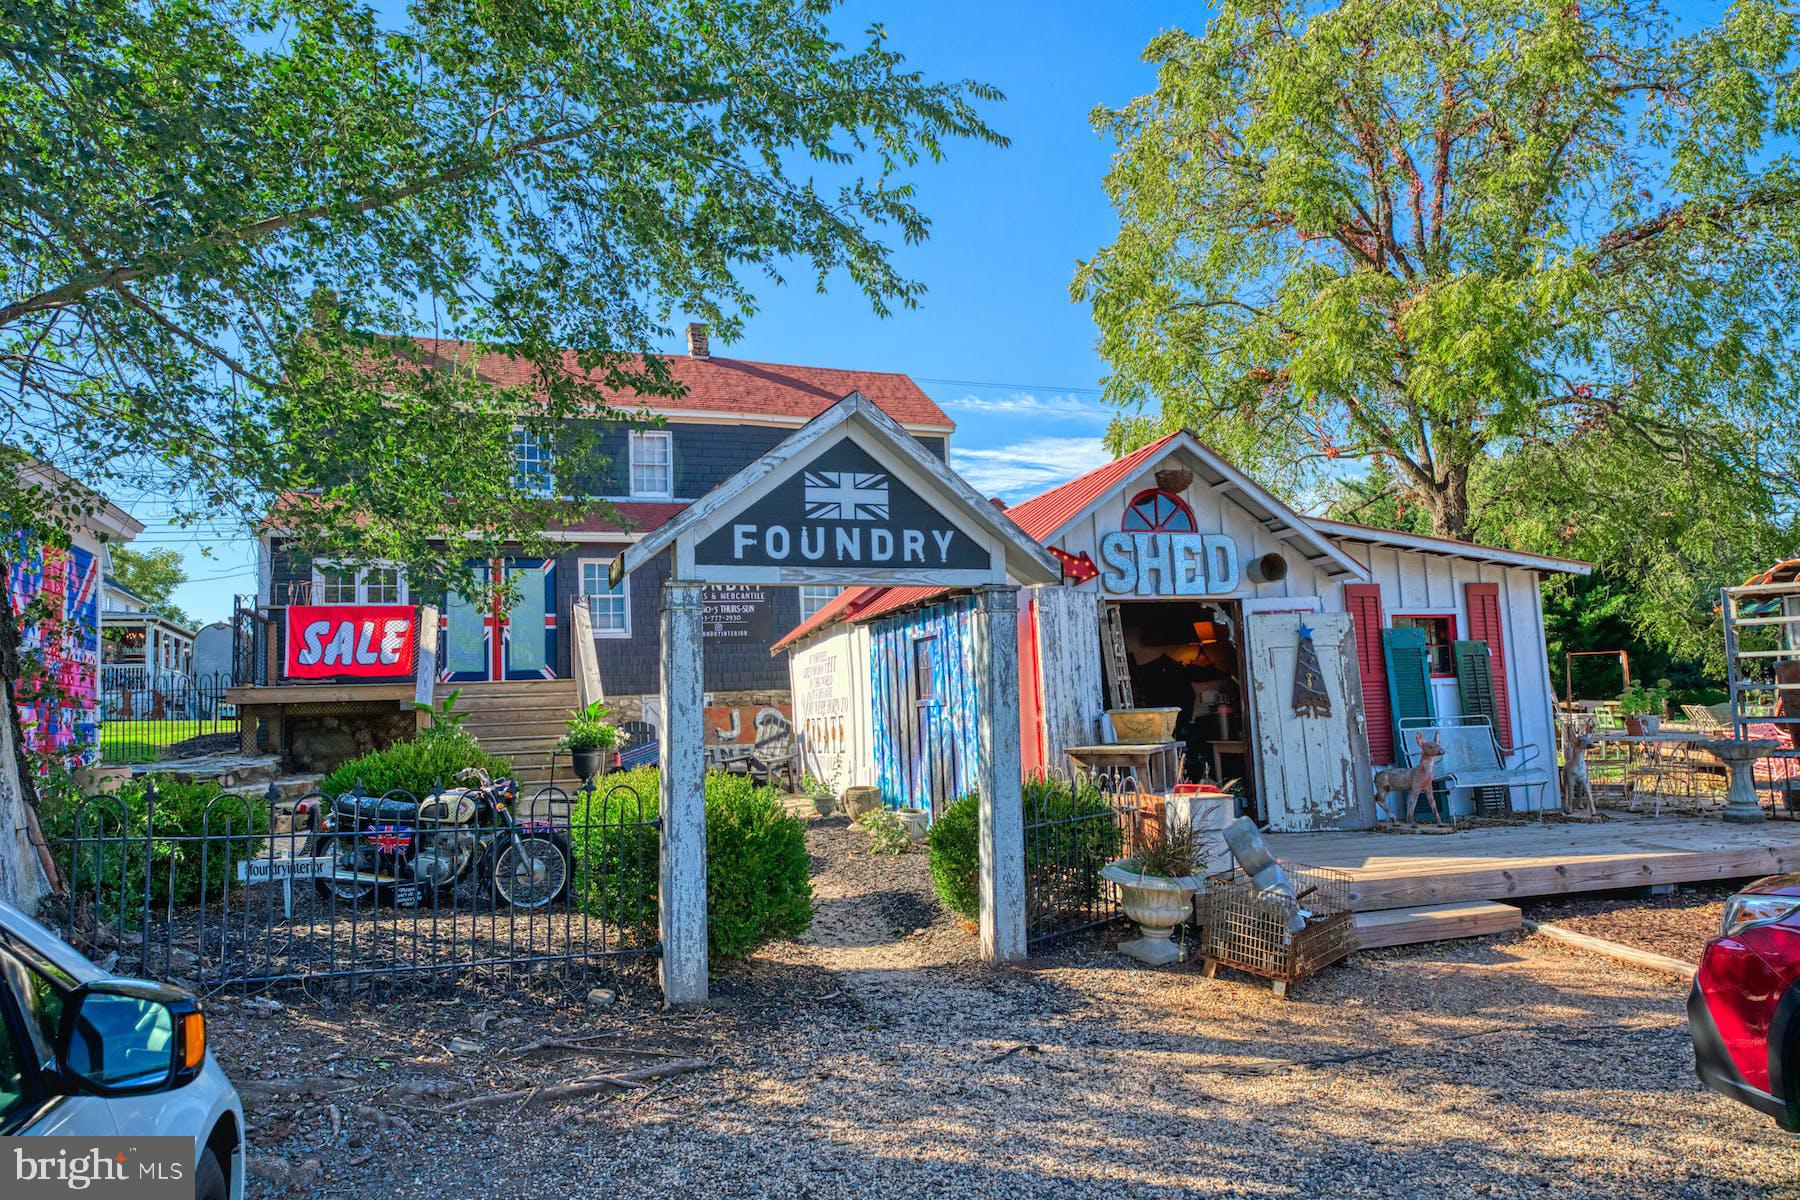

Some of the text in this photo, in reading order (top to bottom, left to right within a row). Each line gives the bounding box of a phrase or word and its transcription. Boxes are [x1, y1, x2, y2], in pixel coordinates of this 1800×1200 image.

[733, 524, 954, 563] FOUNDRY
[1101, 531, 1240, 595] SHED
[720, 591, 766, 600] MERCANTILE
[703, 614, 742, 622] 3-777-2930
[720, 604, 755, 614] THURS-SUN
[298, 619, 410, 666] SALE
